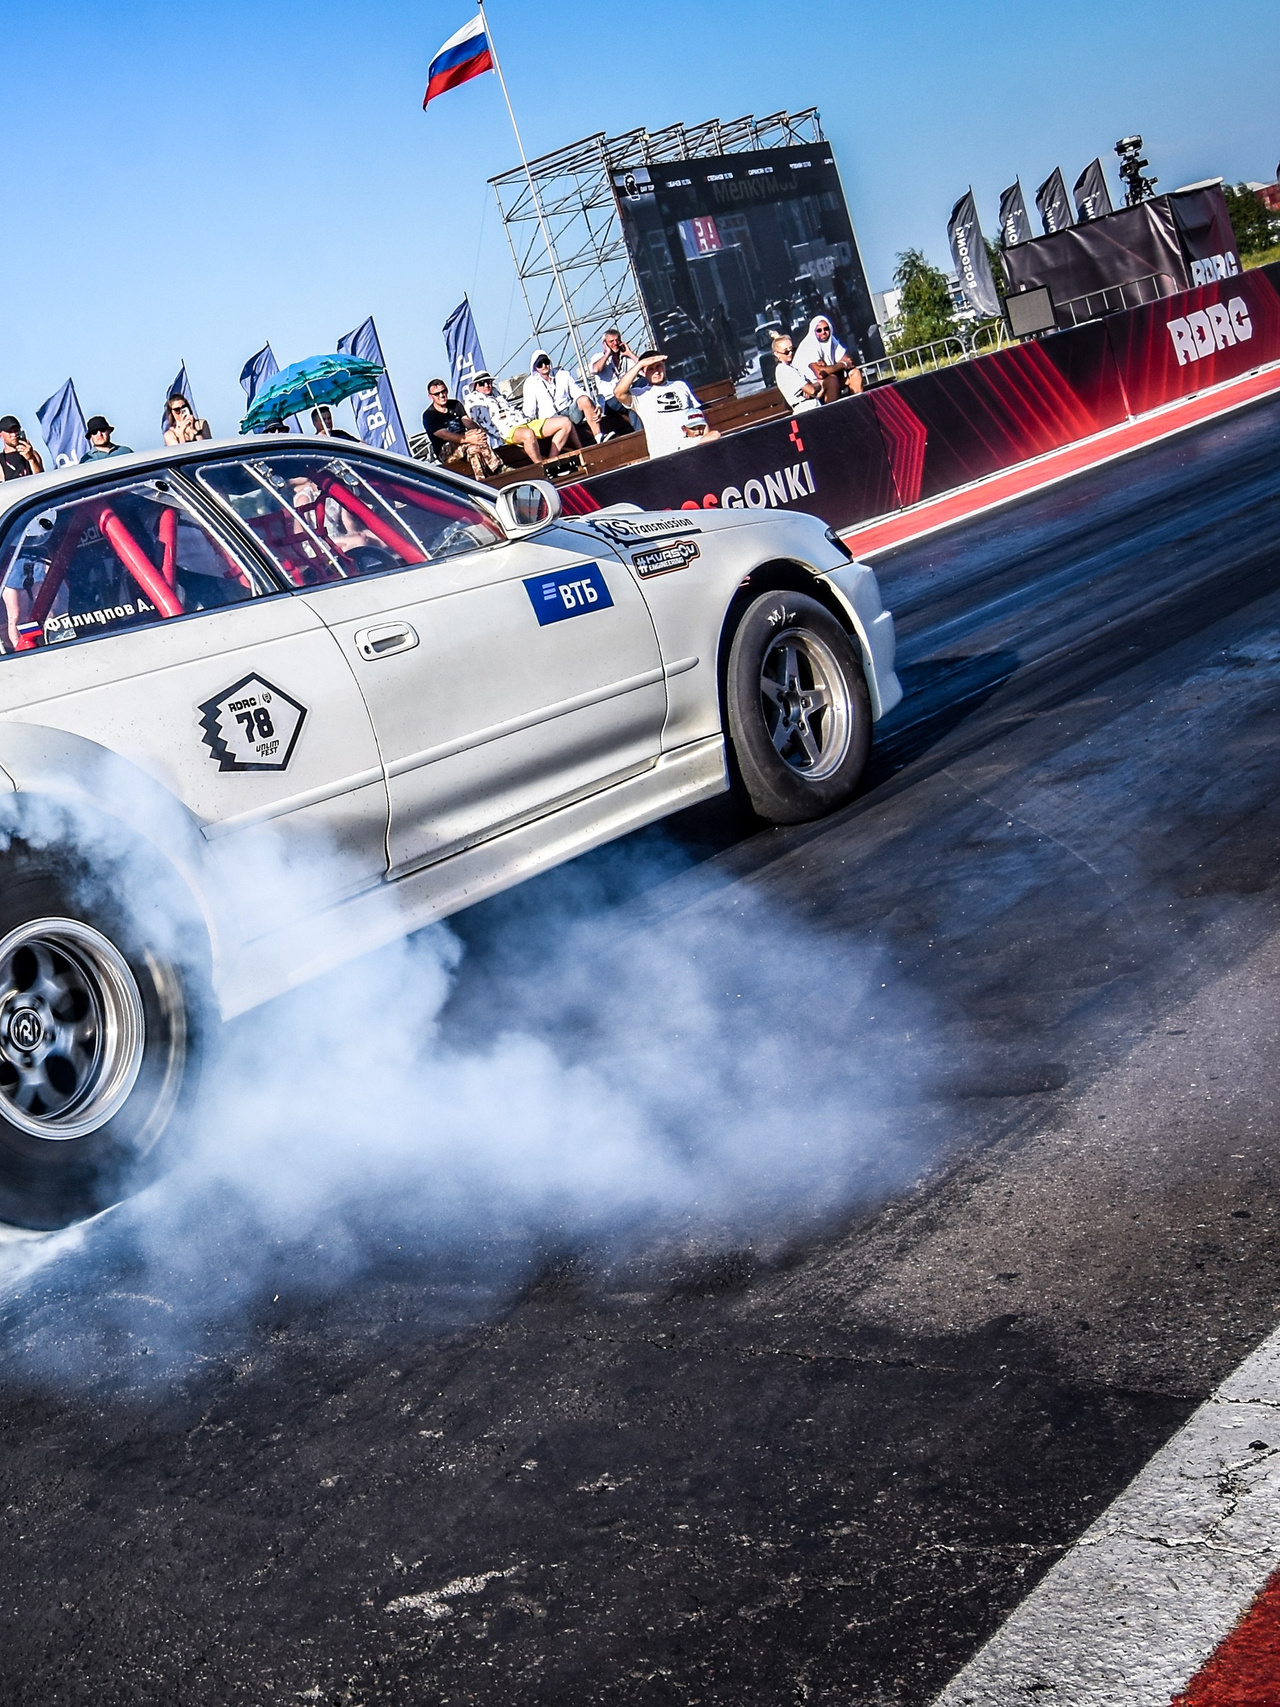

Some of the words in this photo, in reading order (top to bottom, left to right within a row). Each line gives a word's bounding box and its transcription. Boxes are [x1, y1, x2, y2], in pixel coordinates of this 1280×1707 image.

[1190, 251, 1239, 287] RDRC
[1166, 296, 1253, 366] RDRC
[558, 578, 598, 609] ВТБ
[45, 603, 135, 631] Филиппов
[136, 598, 155, 613] А.
[228, 697, 257, 712] RDRC
[235, 707, 274, 743] 78
[261, 747, 278, 757] FEST
